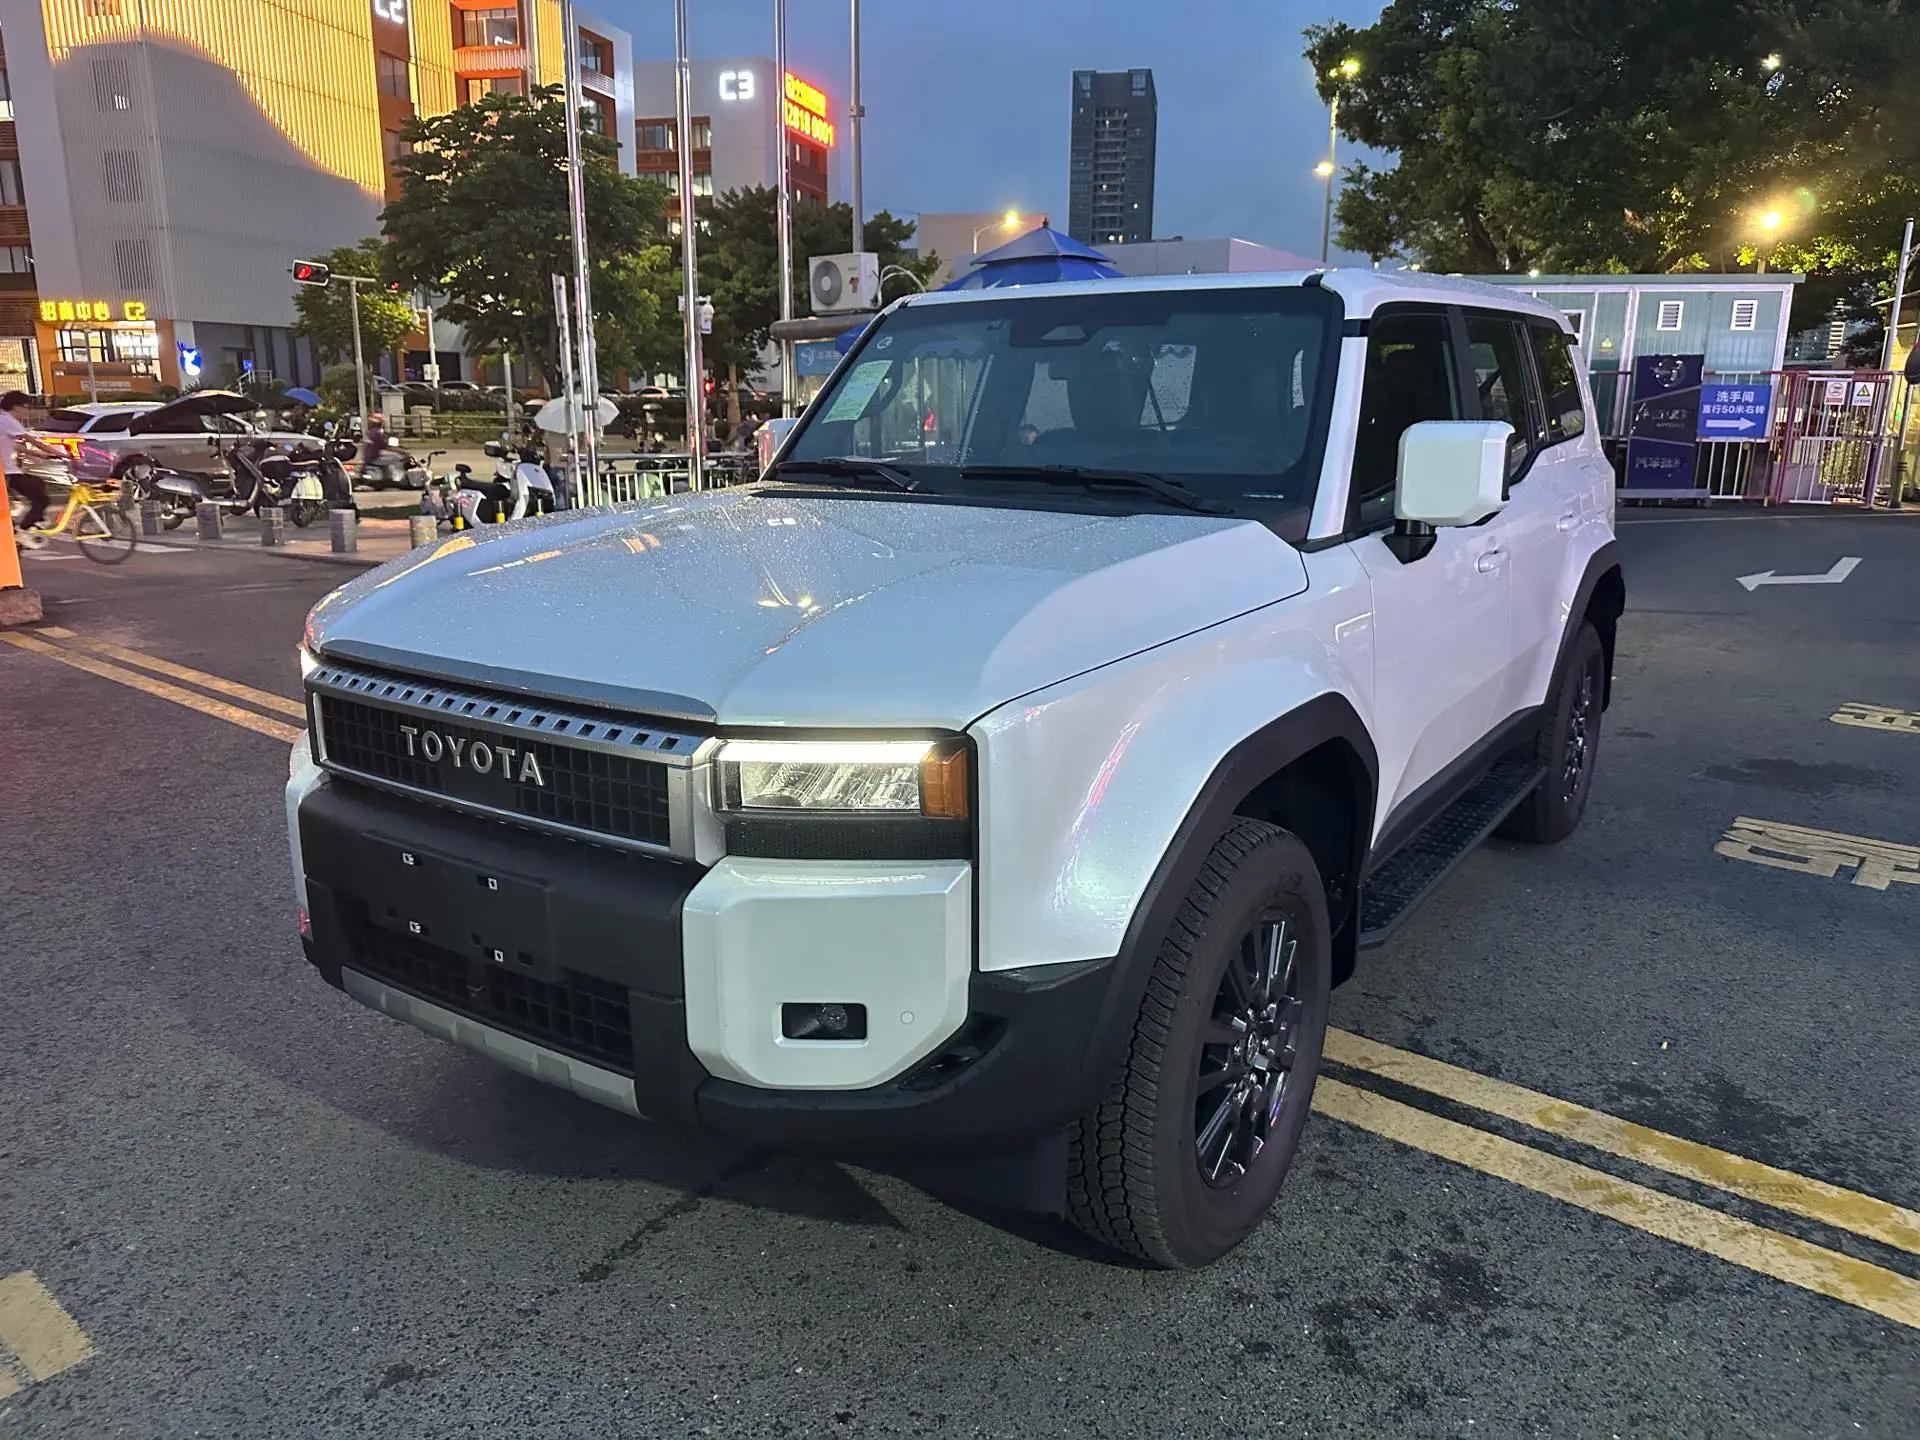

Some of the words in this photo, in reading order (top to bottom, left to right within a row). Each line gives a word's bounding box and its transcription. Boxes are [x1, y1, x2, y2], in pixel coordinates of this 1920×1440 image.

[720, 71, 754, 100] C3
[124, 301, 146, 321] C2
[1715, 390, 1755, 403] 洗手间
[1701, 404, 1766, 415] 直行50米右转
[400, 725, 545, 787] TOYOTA
